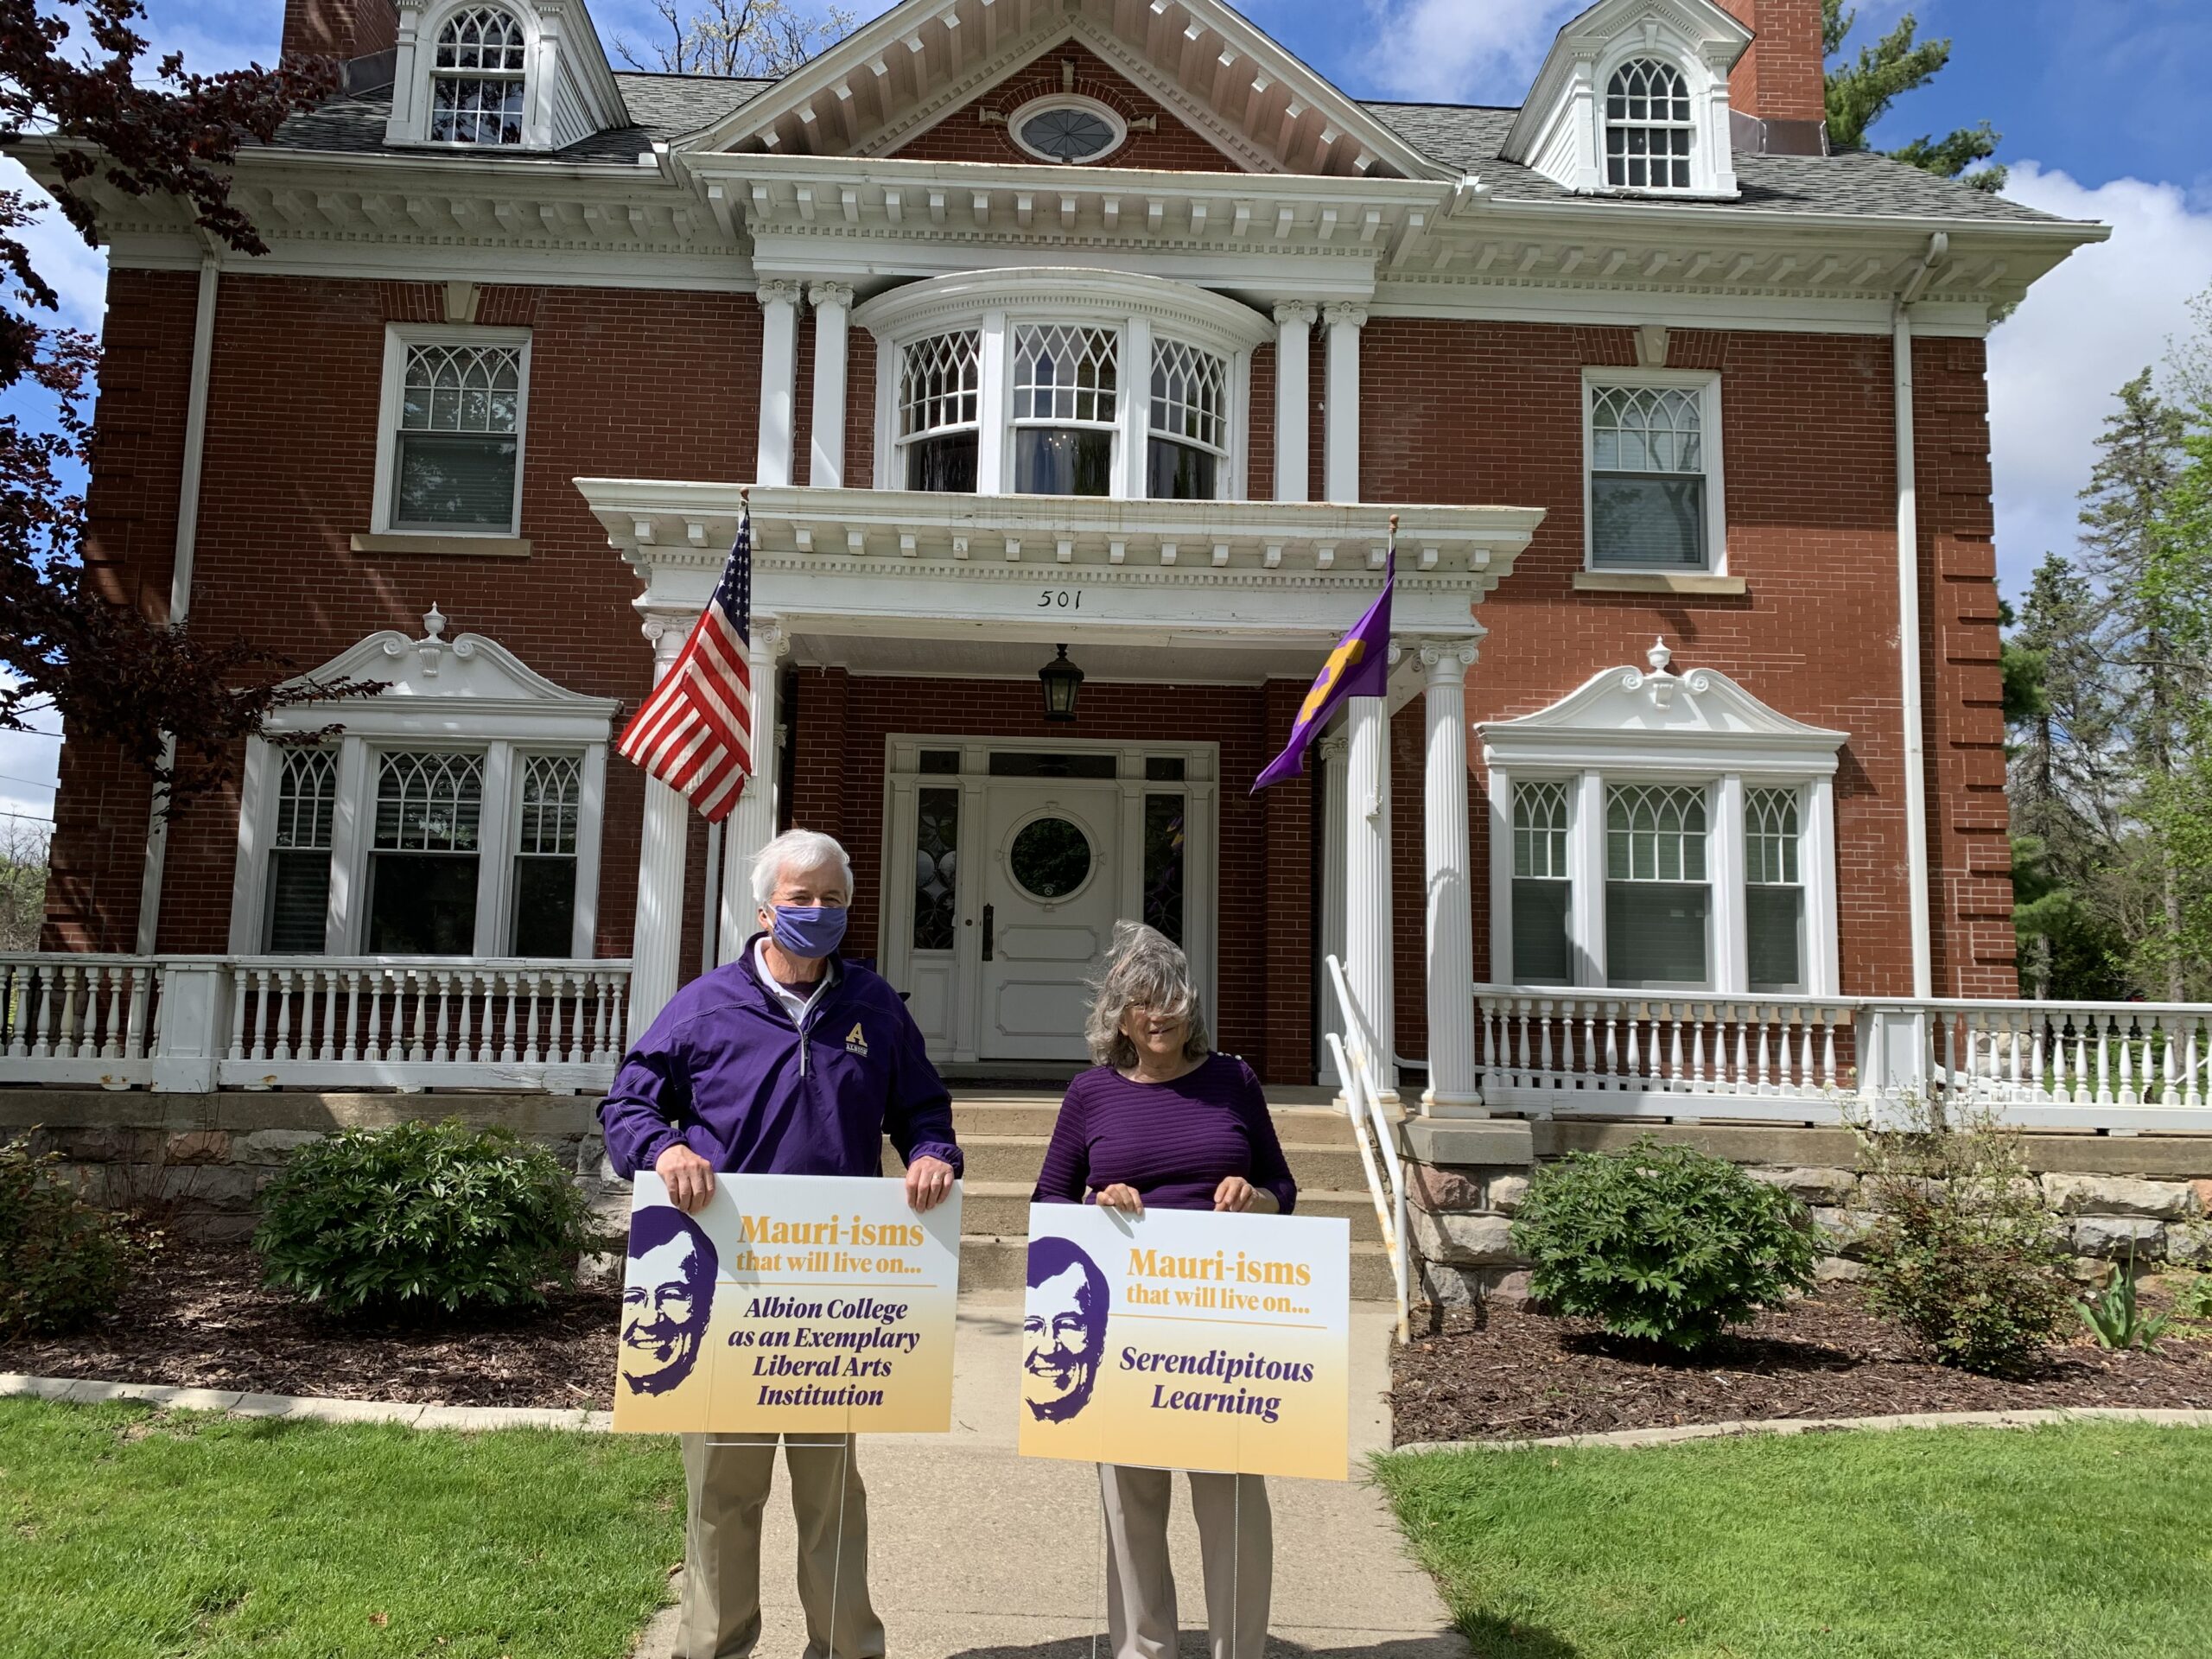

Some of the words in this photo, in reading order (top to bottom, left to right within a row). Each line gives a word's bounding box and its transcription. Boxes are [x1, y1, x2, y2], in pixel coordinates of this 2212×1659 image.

[1037, 590, 1082, 610] 501
[846, 1022, 868, 1047] A
[737, 1215, 925, 1247] Mauri-isms
[736, 1251, 783, 1273] that
[787, 1252, 829, 1273] will
[833, 1252, 873, 1274] live
[876, 1257, 922, 1274] on...
[1127, 1248, 1312, 1286] Mauri-isms
[743, 1297, 823, 1319] Albion
[827, 1298, 908, 1325] College
[1127, 1283, 1171, 1306] that
[1174, 1286, 1217, 1309] will
[1221, 1287, 1259, 1311] live
[1262, 1295, 1310, 1314] on...
[728, 1330, 754, 1348] as
[759, 1331, 790, 1348] an
[793, 1326, 920, 1354] Exemplary
[753, 1354, 841, 1377] Liberal
[842, 1357, 893, 1377] Arts
[1119, 1346, 1314, 1383] Serendipitous
[756, 1384, 884, 1407] Institution
[1150, 1384, 1282, 1424] Learning
